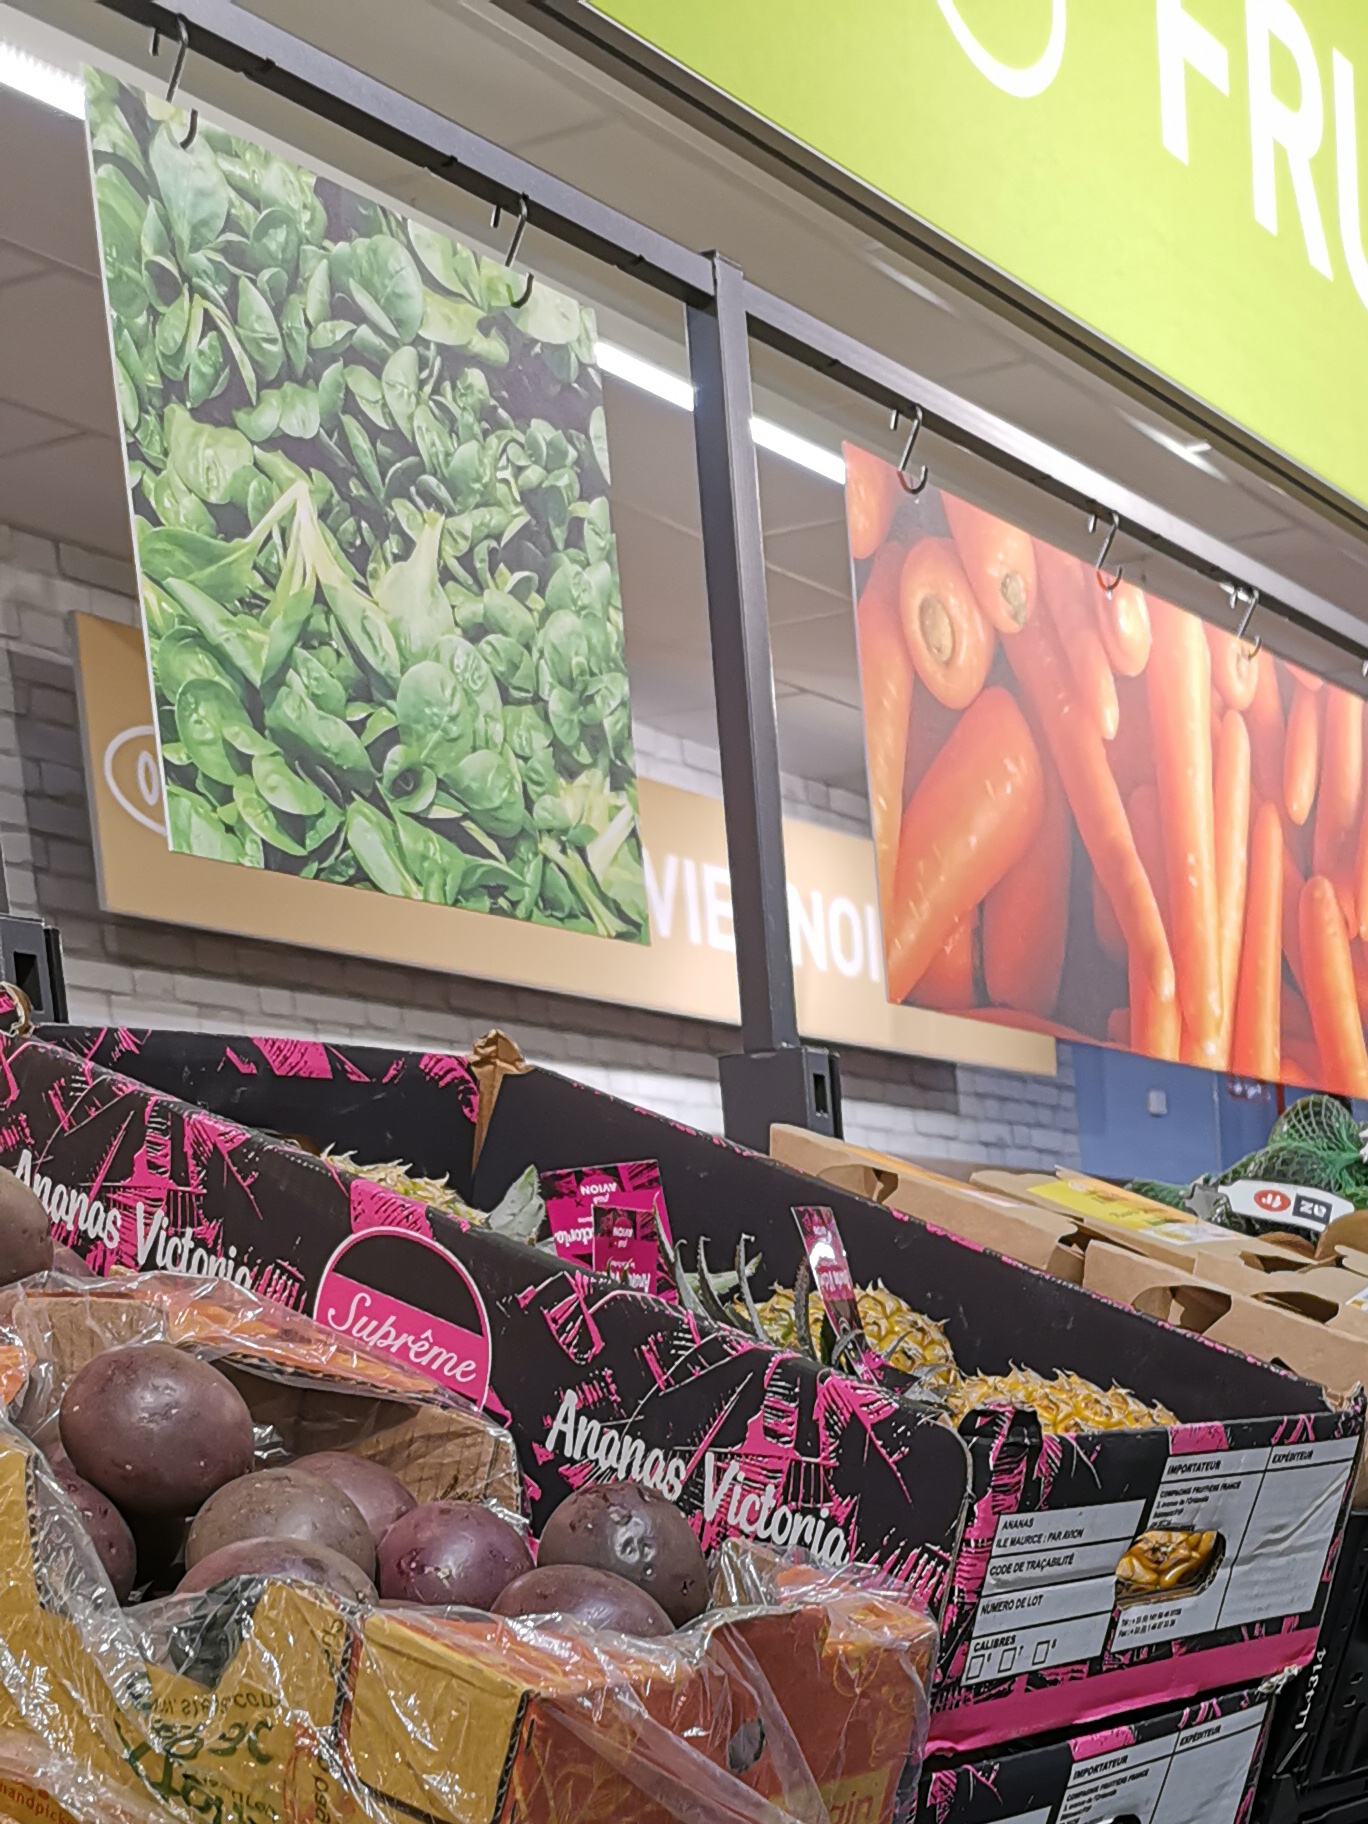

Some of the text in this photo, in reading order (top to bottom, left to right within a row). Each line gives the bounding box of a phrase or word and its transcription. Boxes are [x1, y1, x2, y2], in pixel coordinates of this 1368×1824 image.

[580, 1182, 617, 1196] AVION
[16, 1150, 252, 1289] Ananas Victoria
[328, 1293, 476, 1382] Suprême
[1271, 1450, 1314, 1464] EXPÉDITEUR
[545, 1388, 849, 1566] Ananas Victoria
[1167, 1460, 1222, 1476] IMPORTATEUR
[1001, 1517, 1034, 1531] ANANAS
[1009, 1533, 1042, 1548] MAURICE
[989, 1552, 1075, 1577] CODE DE TRAÇABILITÉ
[1015, 1598, 1026, 1610] DE
[1027, 1594, 1044, 1608] LOT
[973, 1634, 1016, 1653] CALIBRES
[1179, 1725, 1221, 1746] EXPÉDITEUR
[1073, 1755, 1129, 1780] IMPORTATEUR
